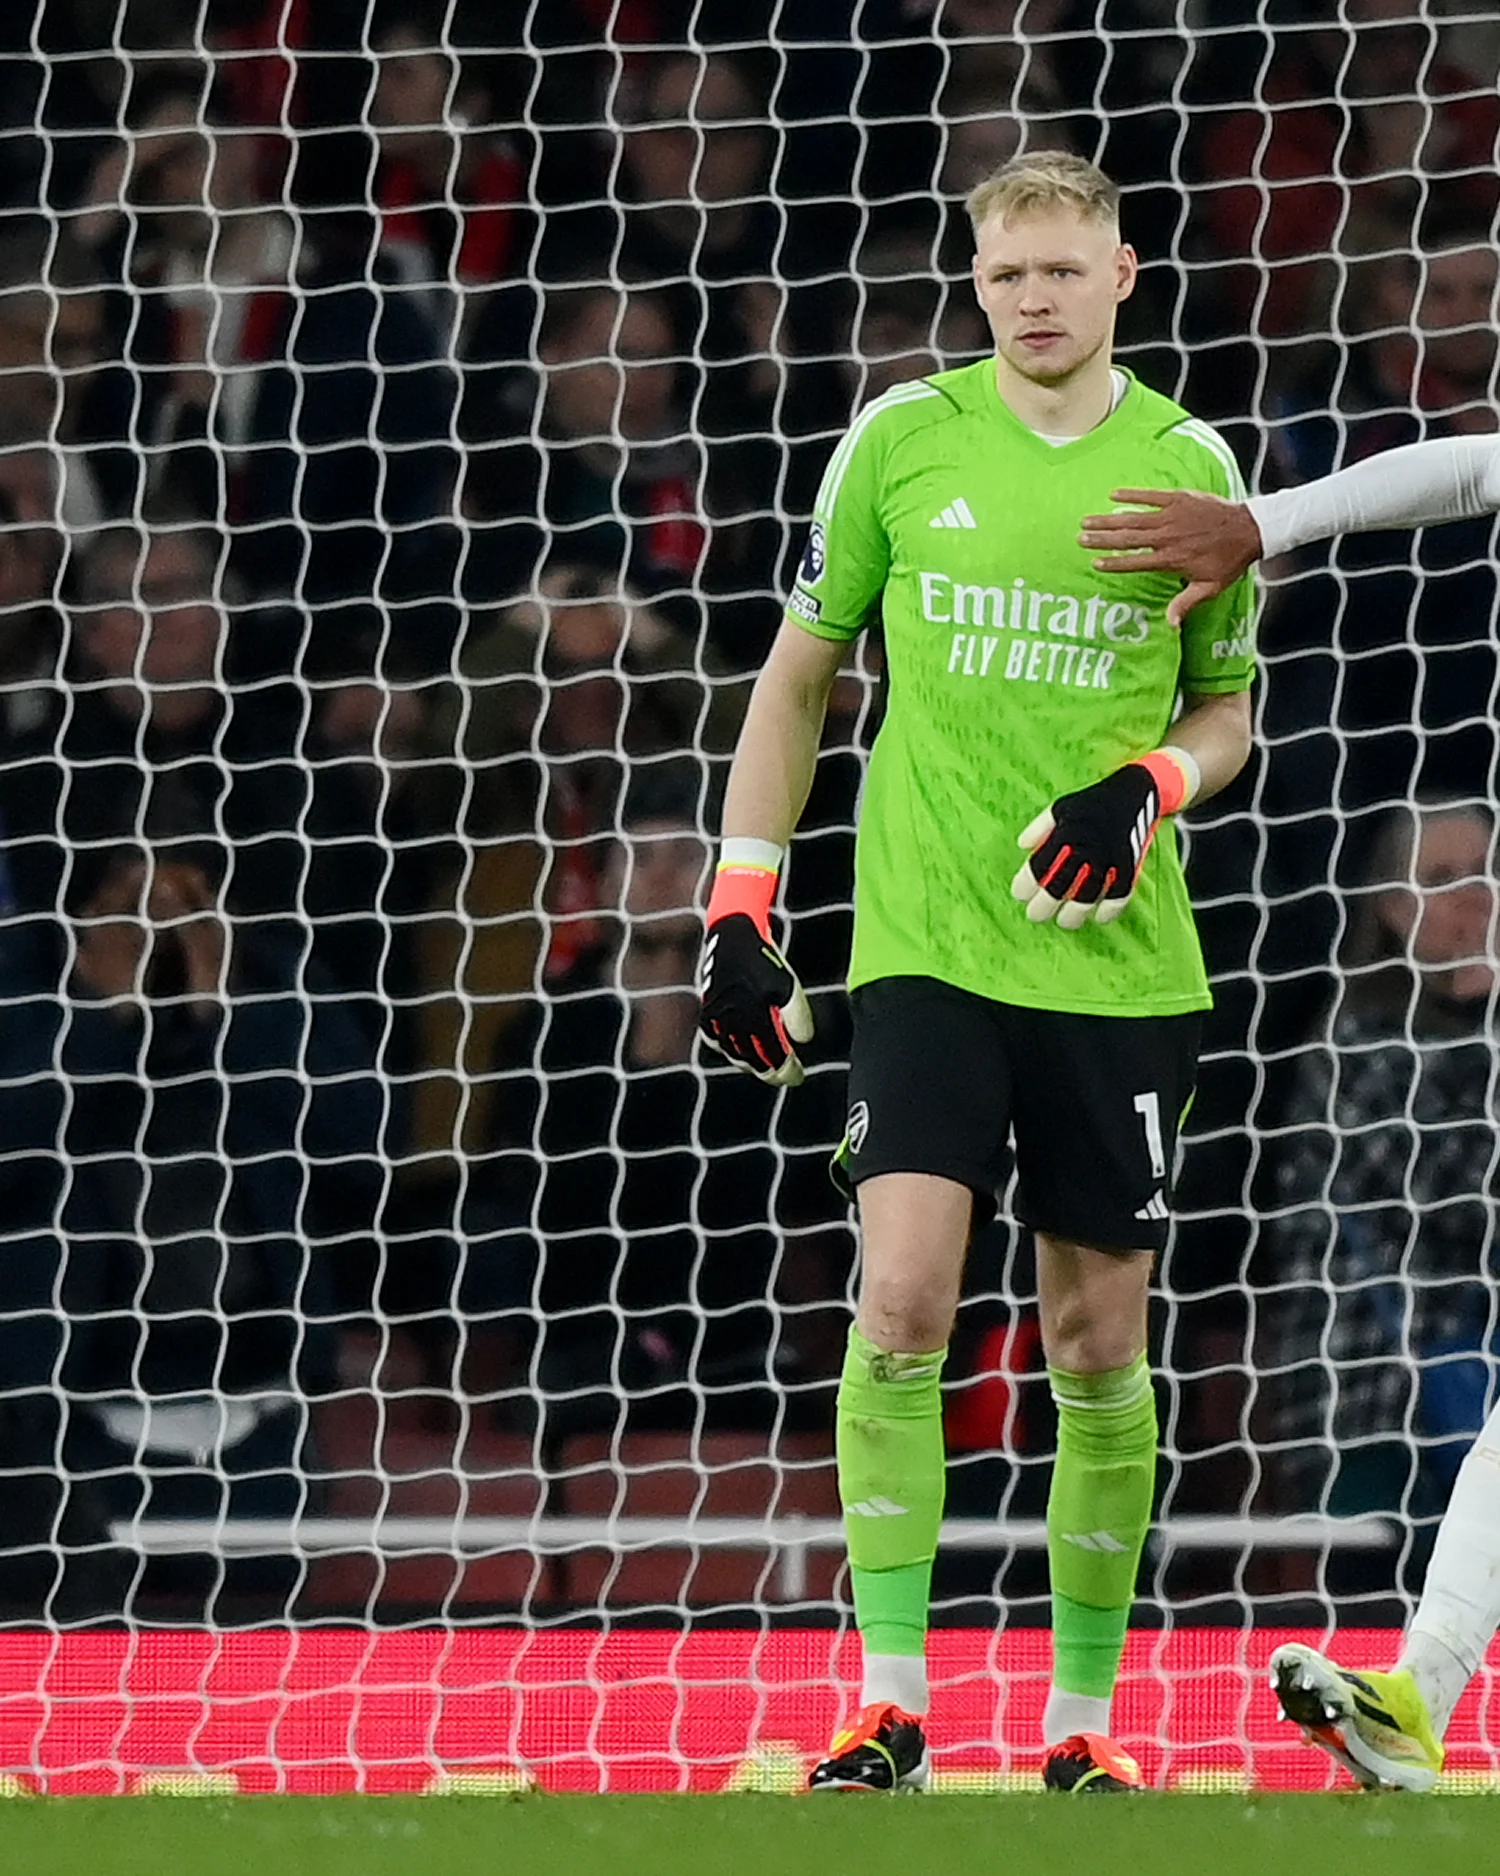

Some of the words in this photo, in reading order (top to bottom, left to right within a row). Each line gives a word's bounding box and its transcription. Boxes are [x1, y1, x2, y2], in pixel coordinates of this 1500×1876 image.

[919, 571, 1150, 644] Emirates
[948, 633, 999, 677] FLY
[1004, 639, 1116, 690] BETTER
[1133, 1091, 1165, 1180] 1
